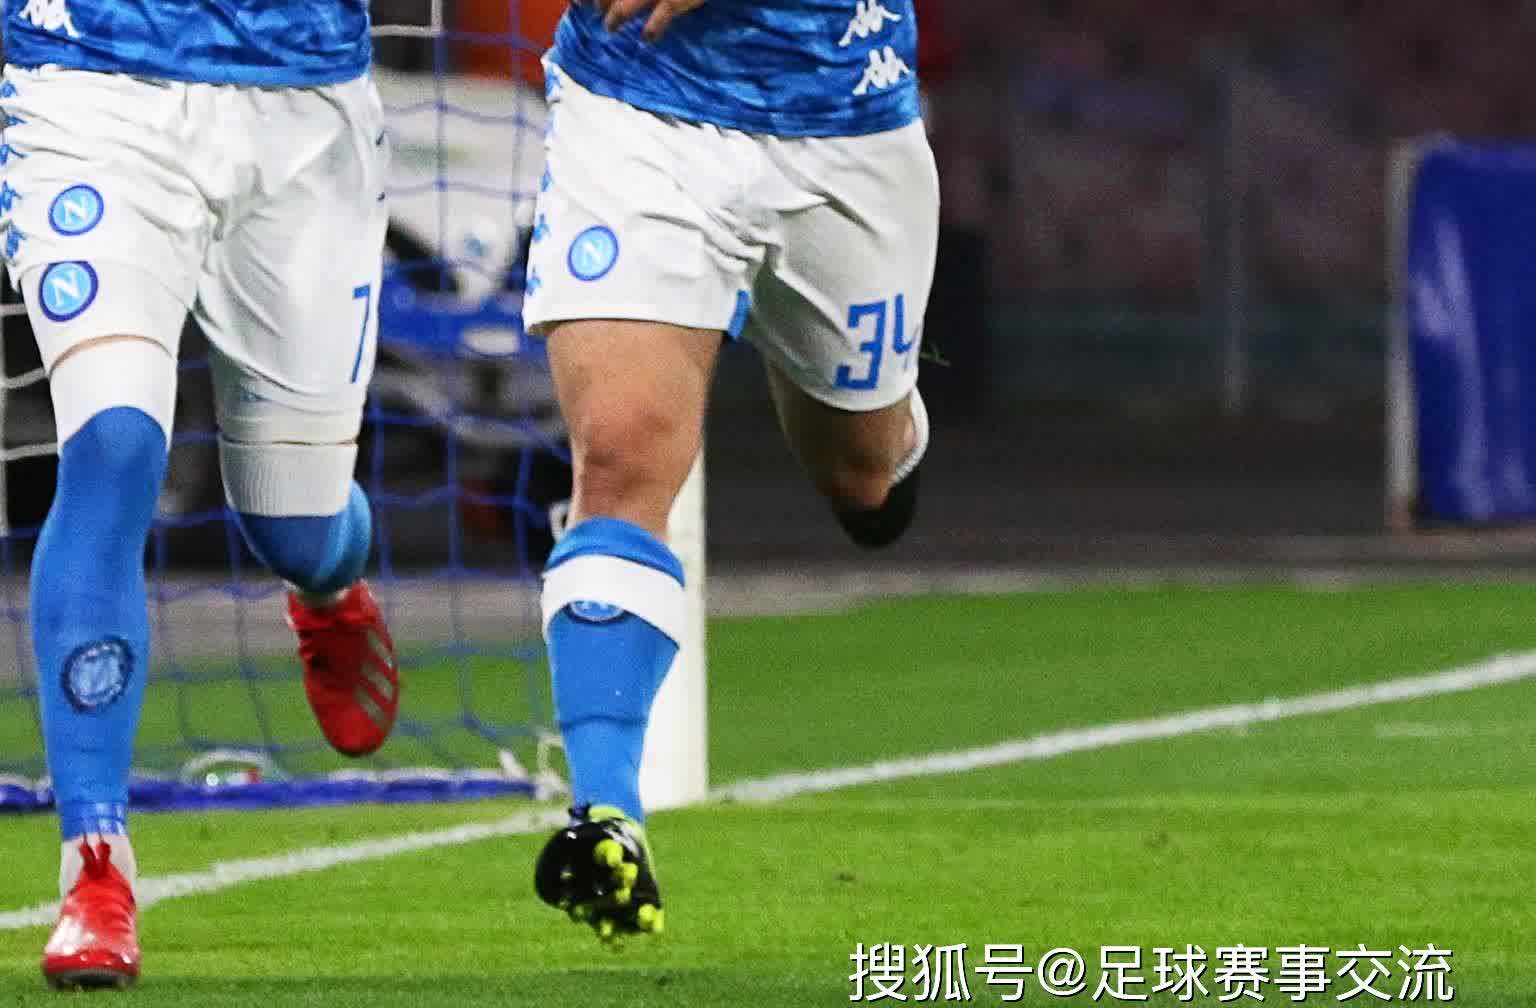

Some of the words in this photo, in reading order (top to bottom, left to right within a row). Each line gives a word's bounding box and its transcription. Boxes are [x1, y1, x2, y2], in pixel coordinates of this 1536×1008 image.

[62, 194, 89, 226] N
[49, 271, 81, 307] N
[353, 283, 371, 384] 7
